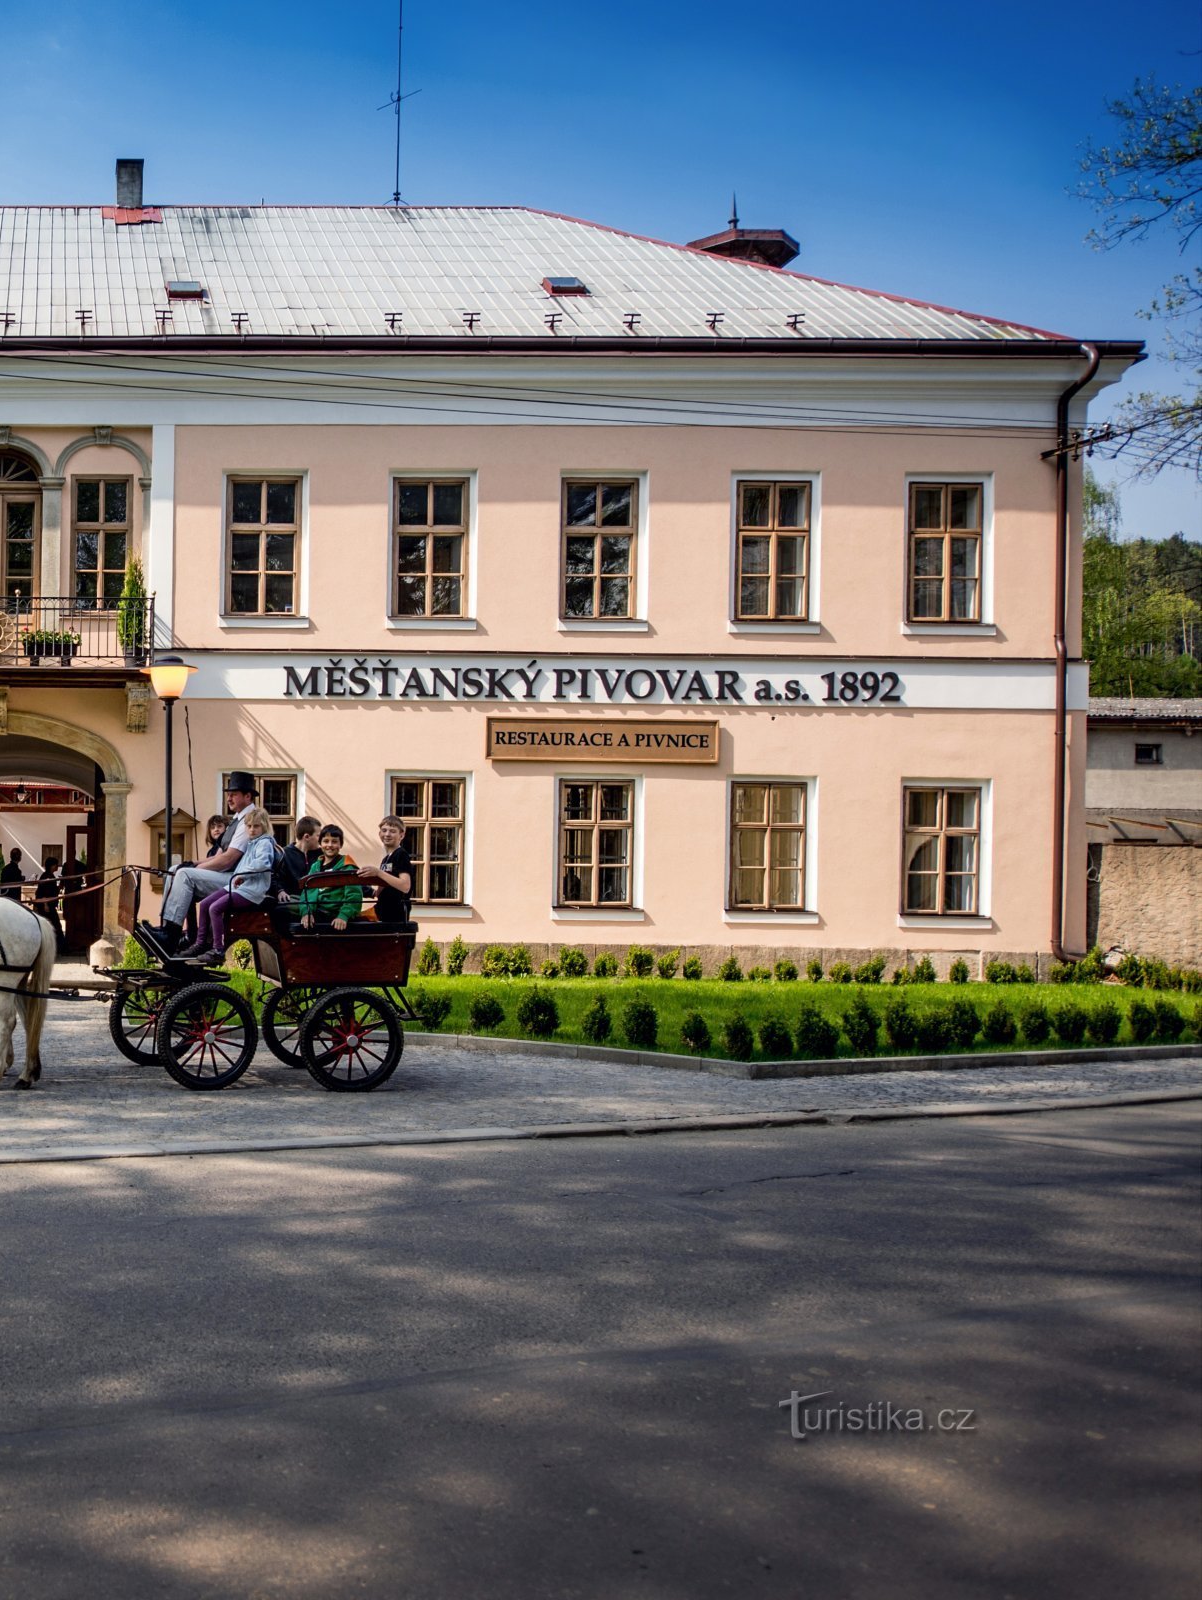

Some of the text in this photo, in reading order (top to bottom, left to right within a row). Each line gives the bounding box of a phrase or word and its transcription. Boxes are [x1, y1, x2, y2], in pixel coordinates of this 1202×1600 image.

[283, 658, 901, 702] MĚŠŤANSKÝ PIVOVAR a.s. 1892
[495, 731, 709, 748] RESTAURACE A PIVNICE
